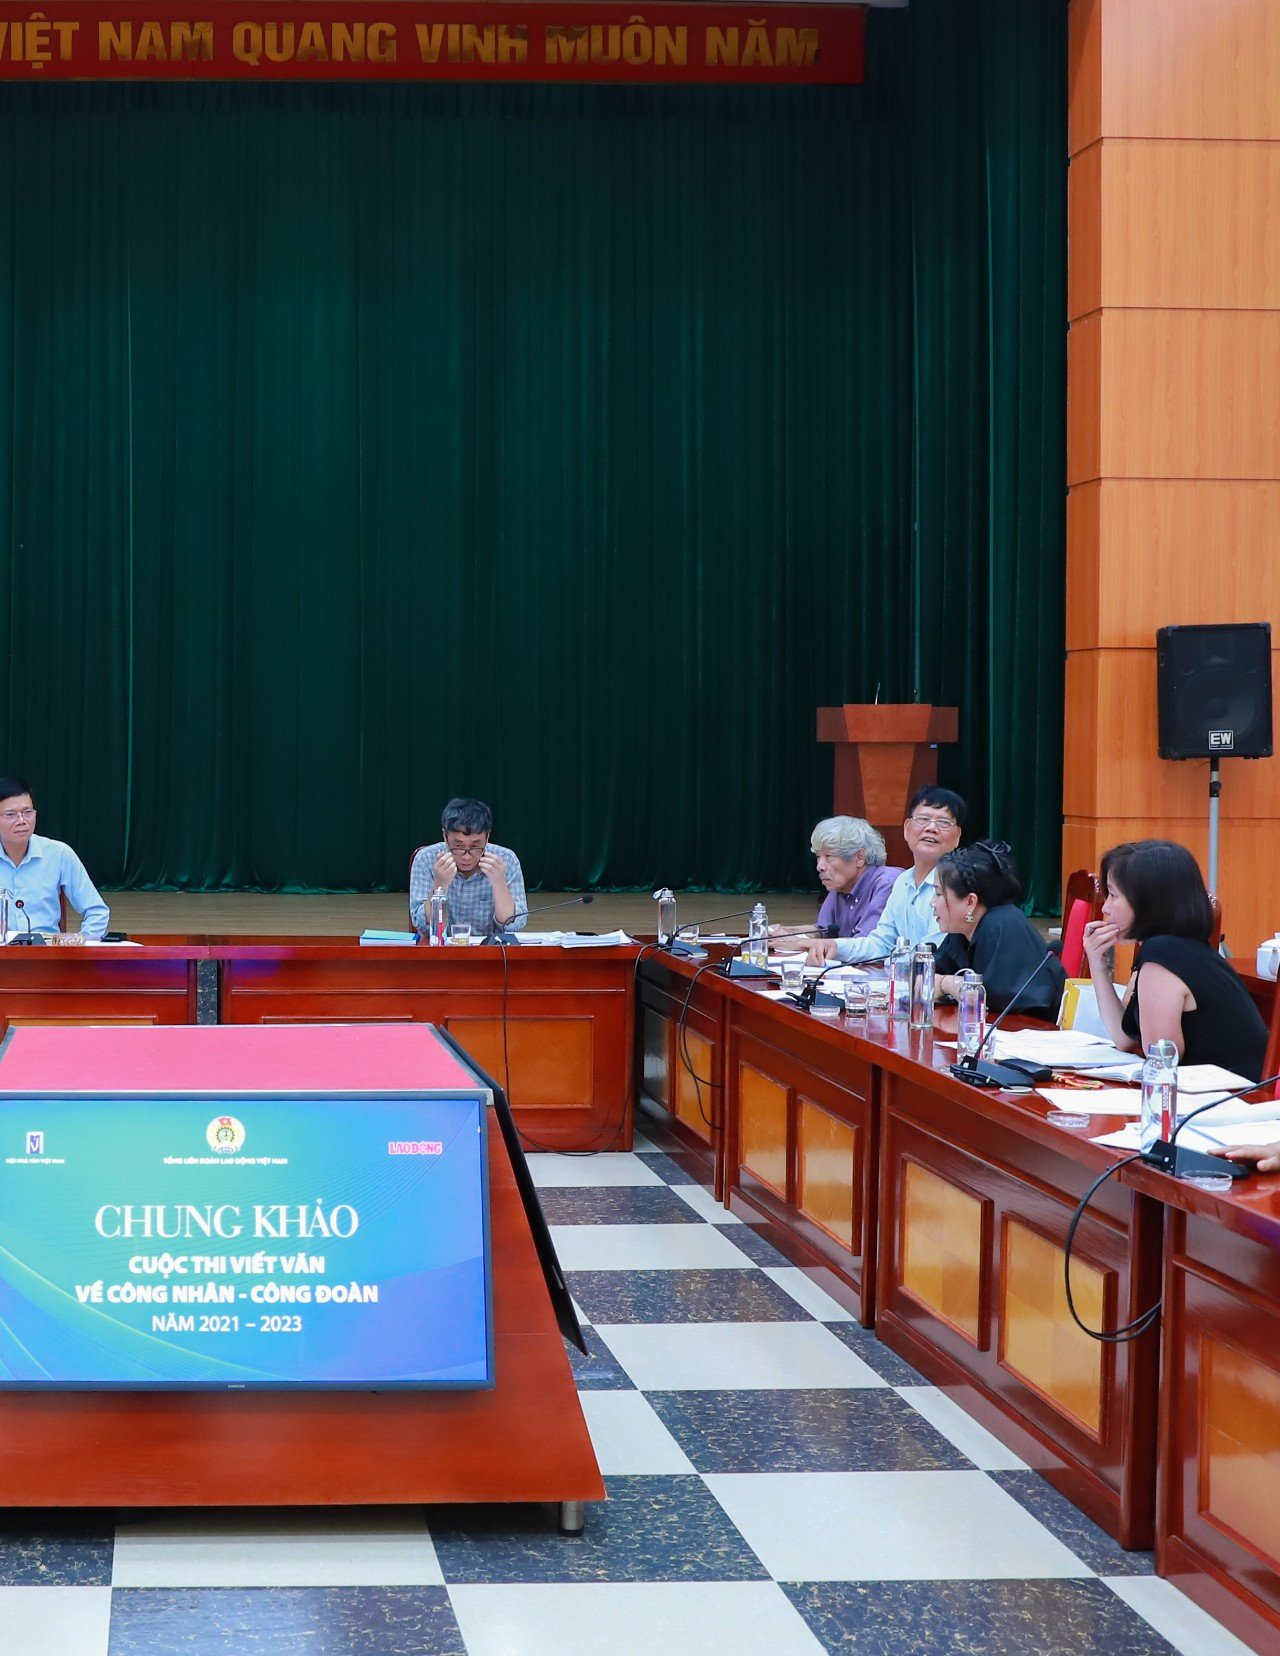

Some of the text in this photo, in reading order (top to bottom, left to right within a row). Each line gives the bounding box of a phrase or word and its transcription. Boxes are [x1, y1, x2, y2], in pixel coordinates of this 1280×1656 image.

[98, 21, 214, 62] NAM
[232, 21, 398, 65] QUANG
[415, 23, 528, 64] VINH
[545, 16, 688, 66] MUÔN
[705, 18, 820, 67] NĂM
[1211, 732, 1231, 744] EW
[94, 1199, 359, 1238] CHUNG KHẢO
[128, 1250, 325, 1279] CUỘC THI VIẾT VĂN
[75, 1280, 104, 1303] VỀ
[106, 1282, 168, 1303] CÔNG
[172, 1282, 235, 1303] NHÂN
[250, 1282, 311, 1303] CÔNG
[314, 1282, 379, 1303] ĐOÀN
[152, 1312, 195, 1332] NĂM
[199, 1315, 240, 1332] 2021
[260, 1315, 302, 1332] 2023
